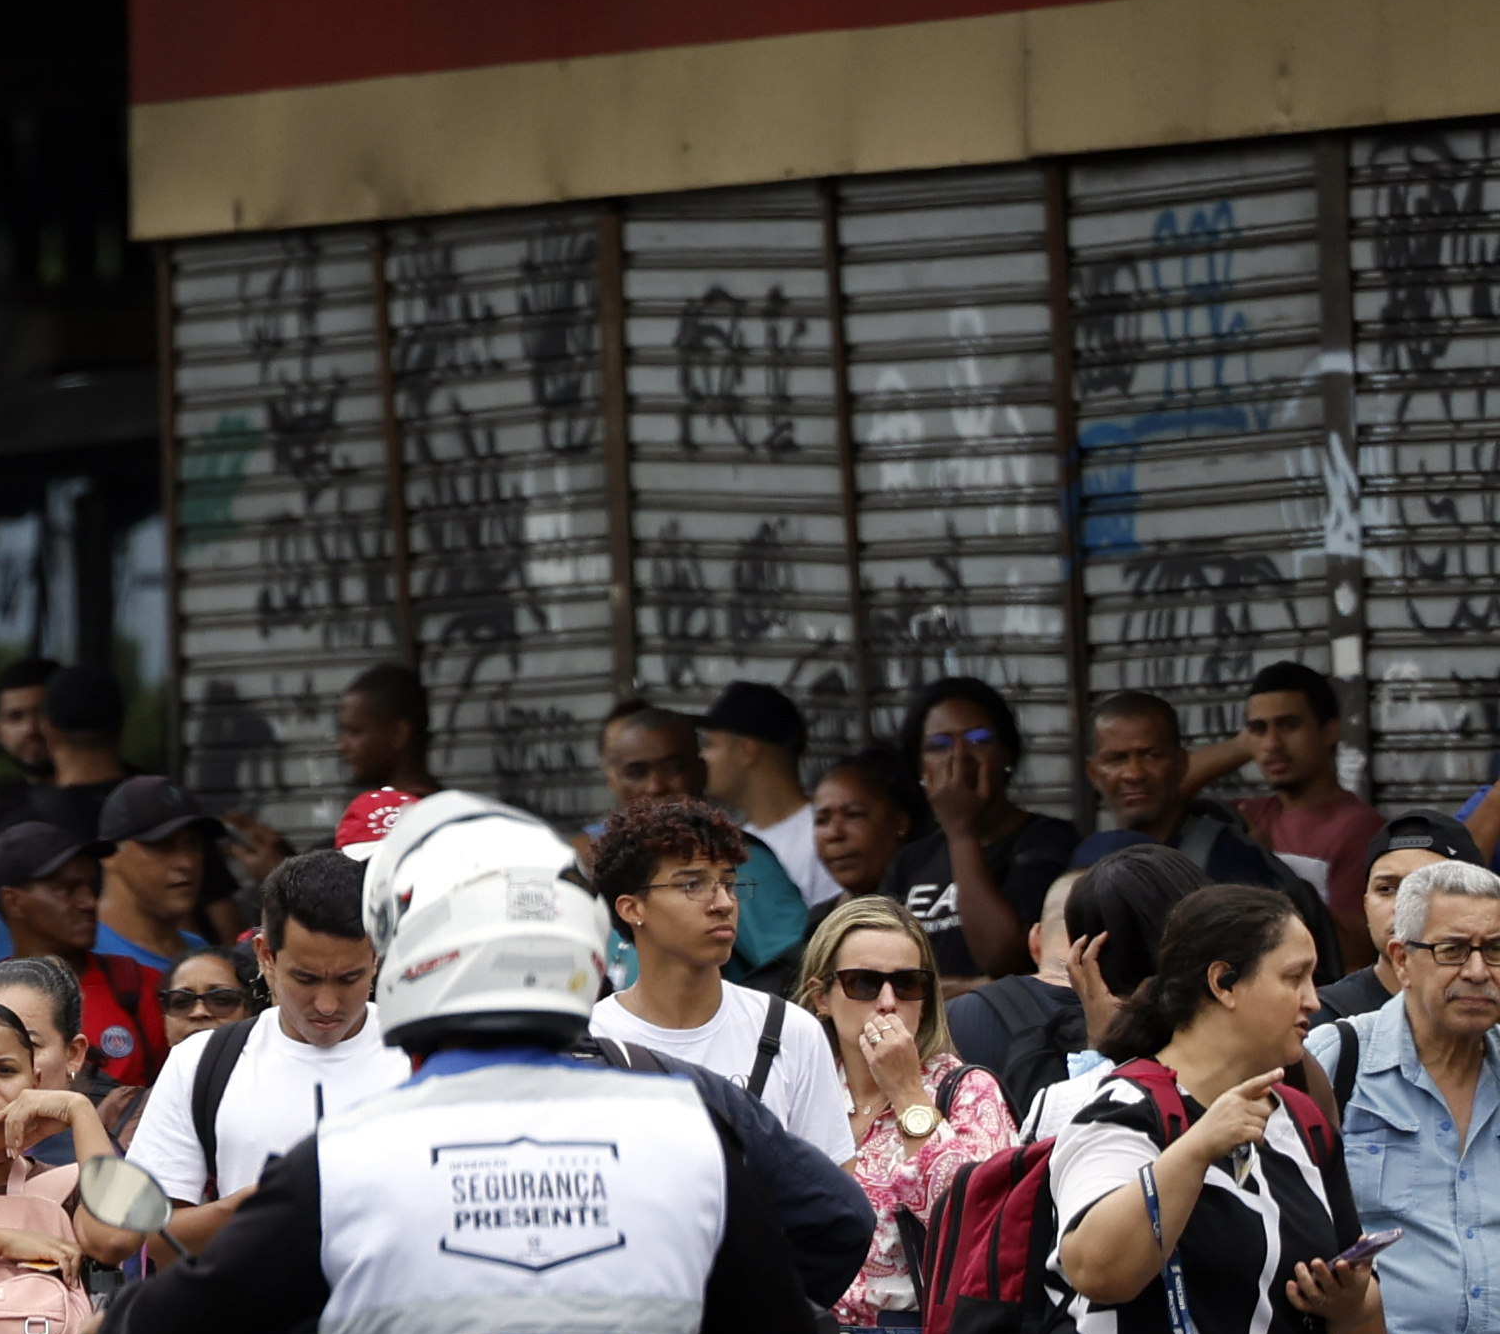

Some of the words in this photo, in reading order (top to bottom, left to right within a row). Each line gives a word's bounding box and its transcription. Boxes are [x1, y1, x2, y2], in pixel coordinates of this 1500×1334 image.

[906, 882, 958, 917] EA
[451, 1171, 607, 1207] SEGURANÇA
[453, 1204, 609, 1232] PRESENTE
